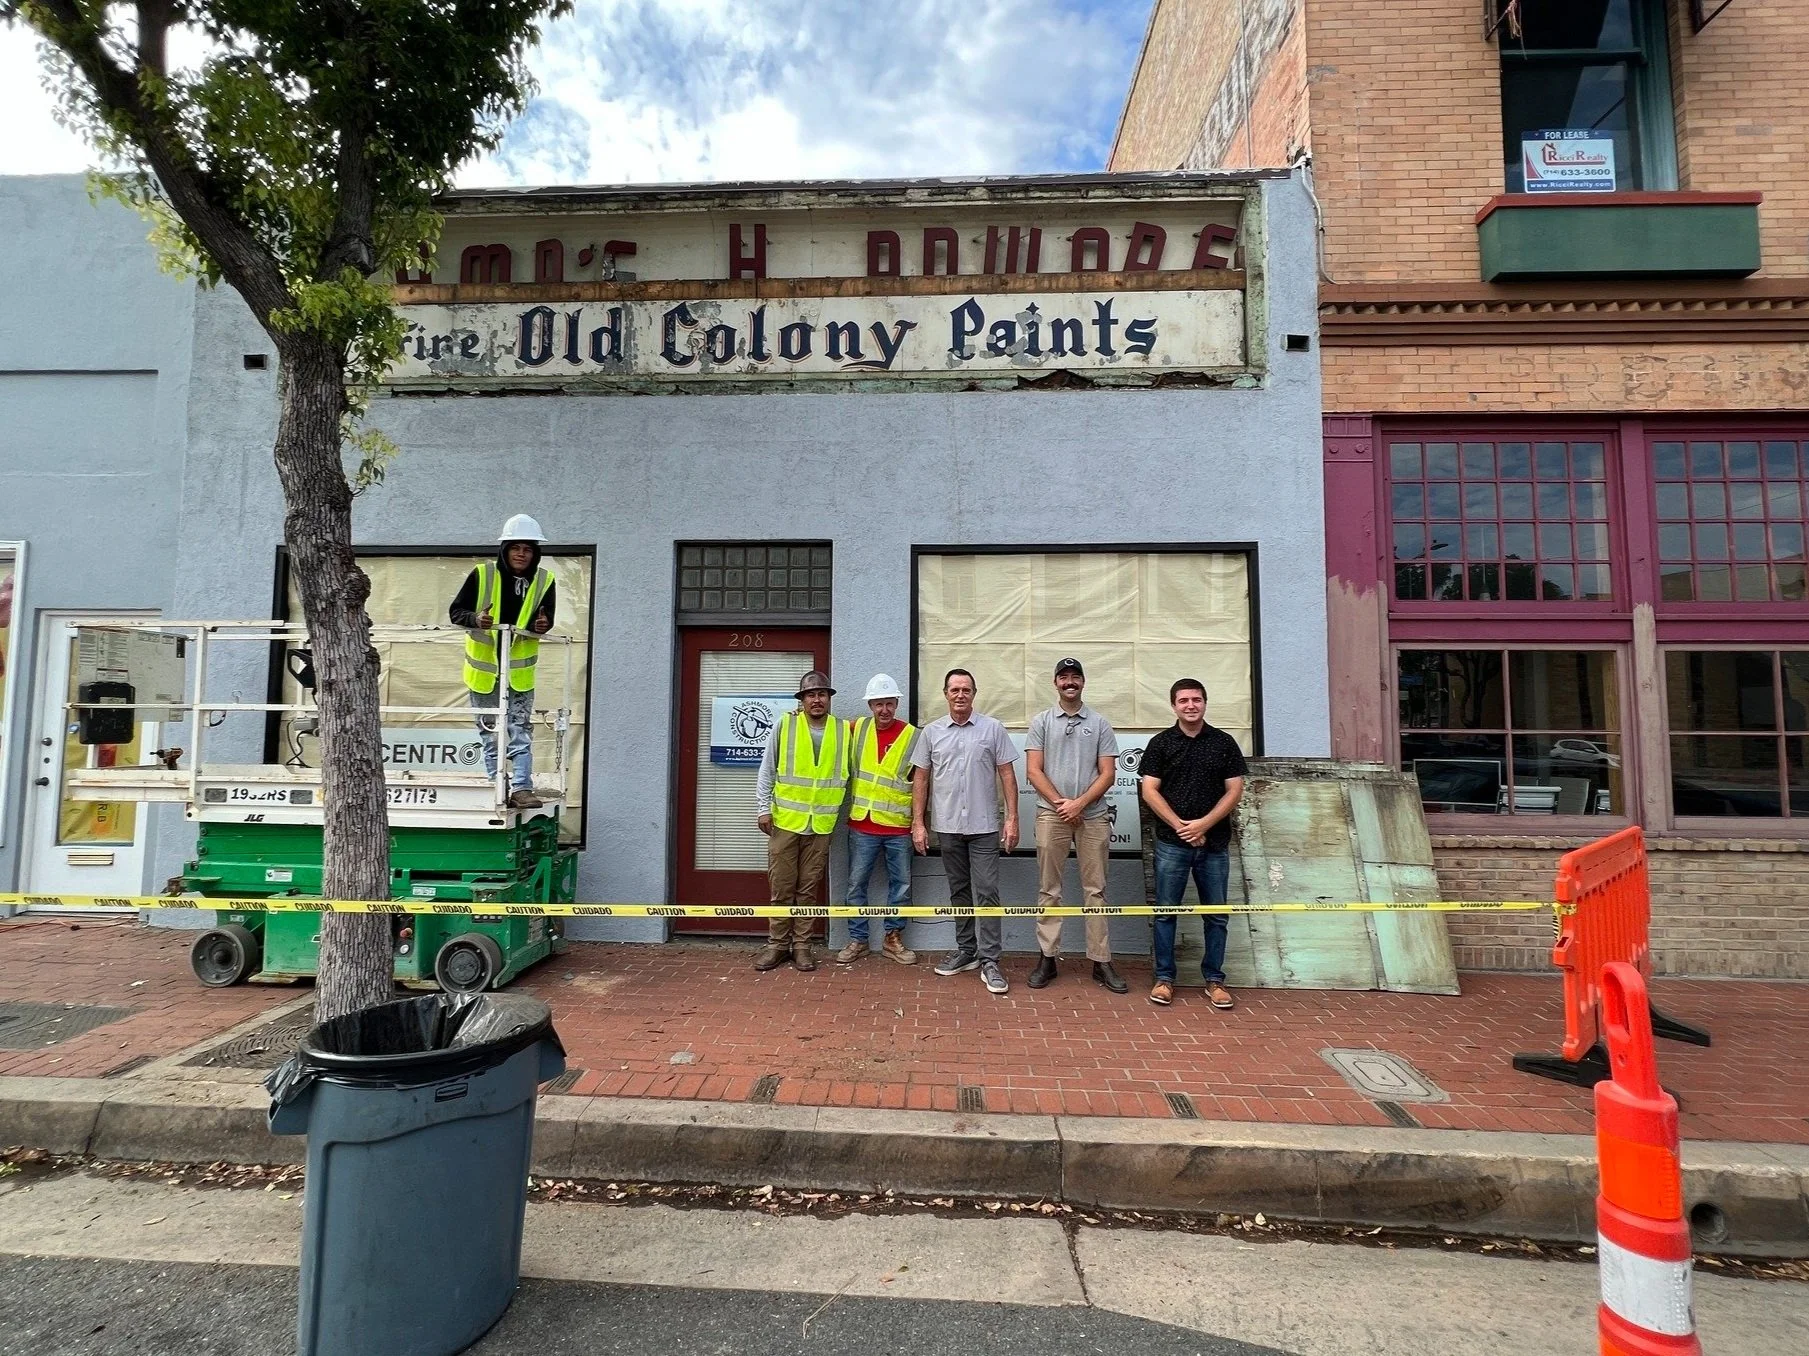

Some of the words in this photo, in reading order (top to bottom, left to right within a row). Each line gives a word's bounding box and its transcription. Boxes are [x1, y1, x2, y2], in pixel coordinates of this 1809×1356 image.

[1544, 131, 1561, 139] FOR
[1563, 131, 1589, 139] LEASE
[1561, 168, 1610, 176] 633-3600
[519, 305, 627, 367] Old
[658, 300, 918, 370] Colony
[949, 297, 1160, 361] Paints
[728, 633, 765, 648] 208
[741, 700, 774, 719] ASHMORE
[730, 712, 771, 746] CONSTRUCTION
[243, 813, 266, 822] JLG
[229, 901, 269, 910] CAUTION
[294, 902, 334, 911] CUIDADO
[366, 904, 406, 912] CAUTION
[432, 905, 473, 914] CUIDADO
[505, 906, 546, 915] CAUTION
[572, 907, 612, 915] CUIDADO
[646, 907, 686, 916] CAUTION
[714, 907, 754, 916] CUIDADO
[789, 907, 829, 916] CAUTION
